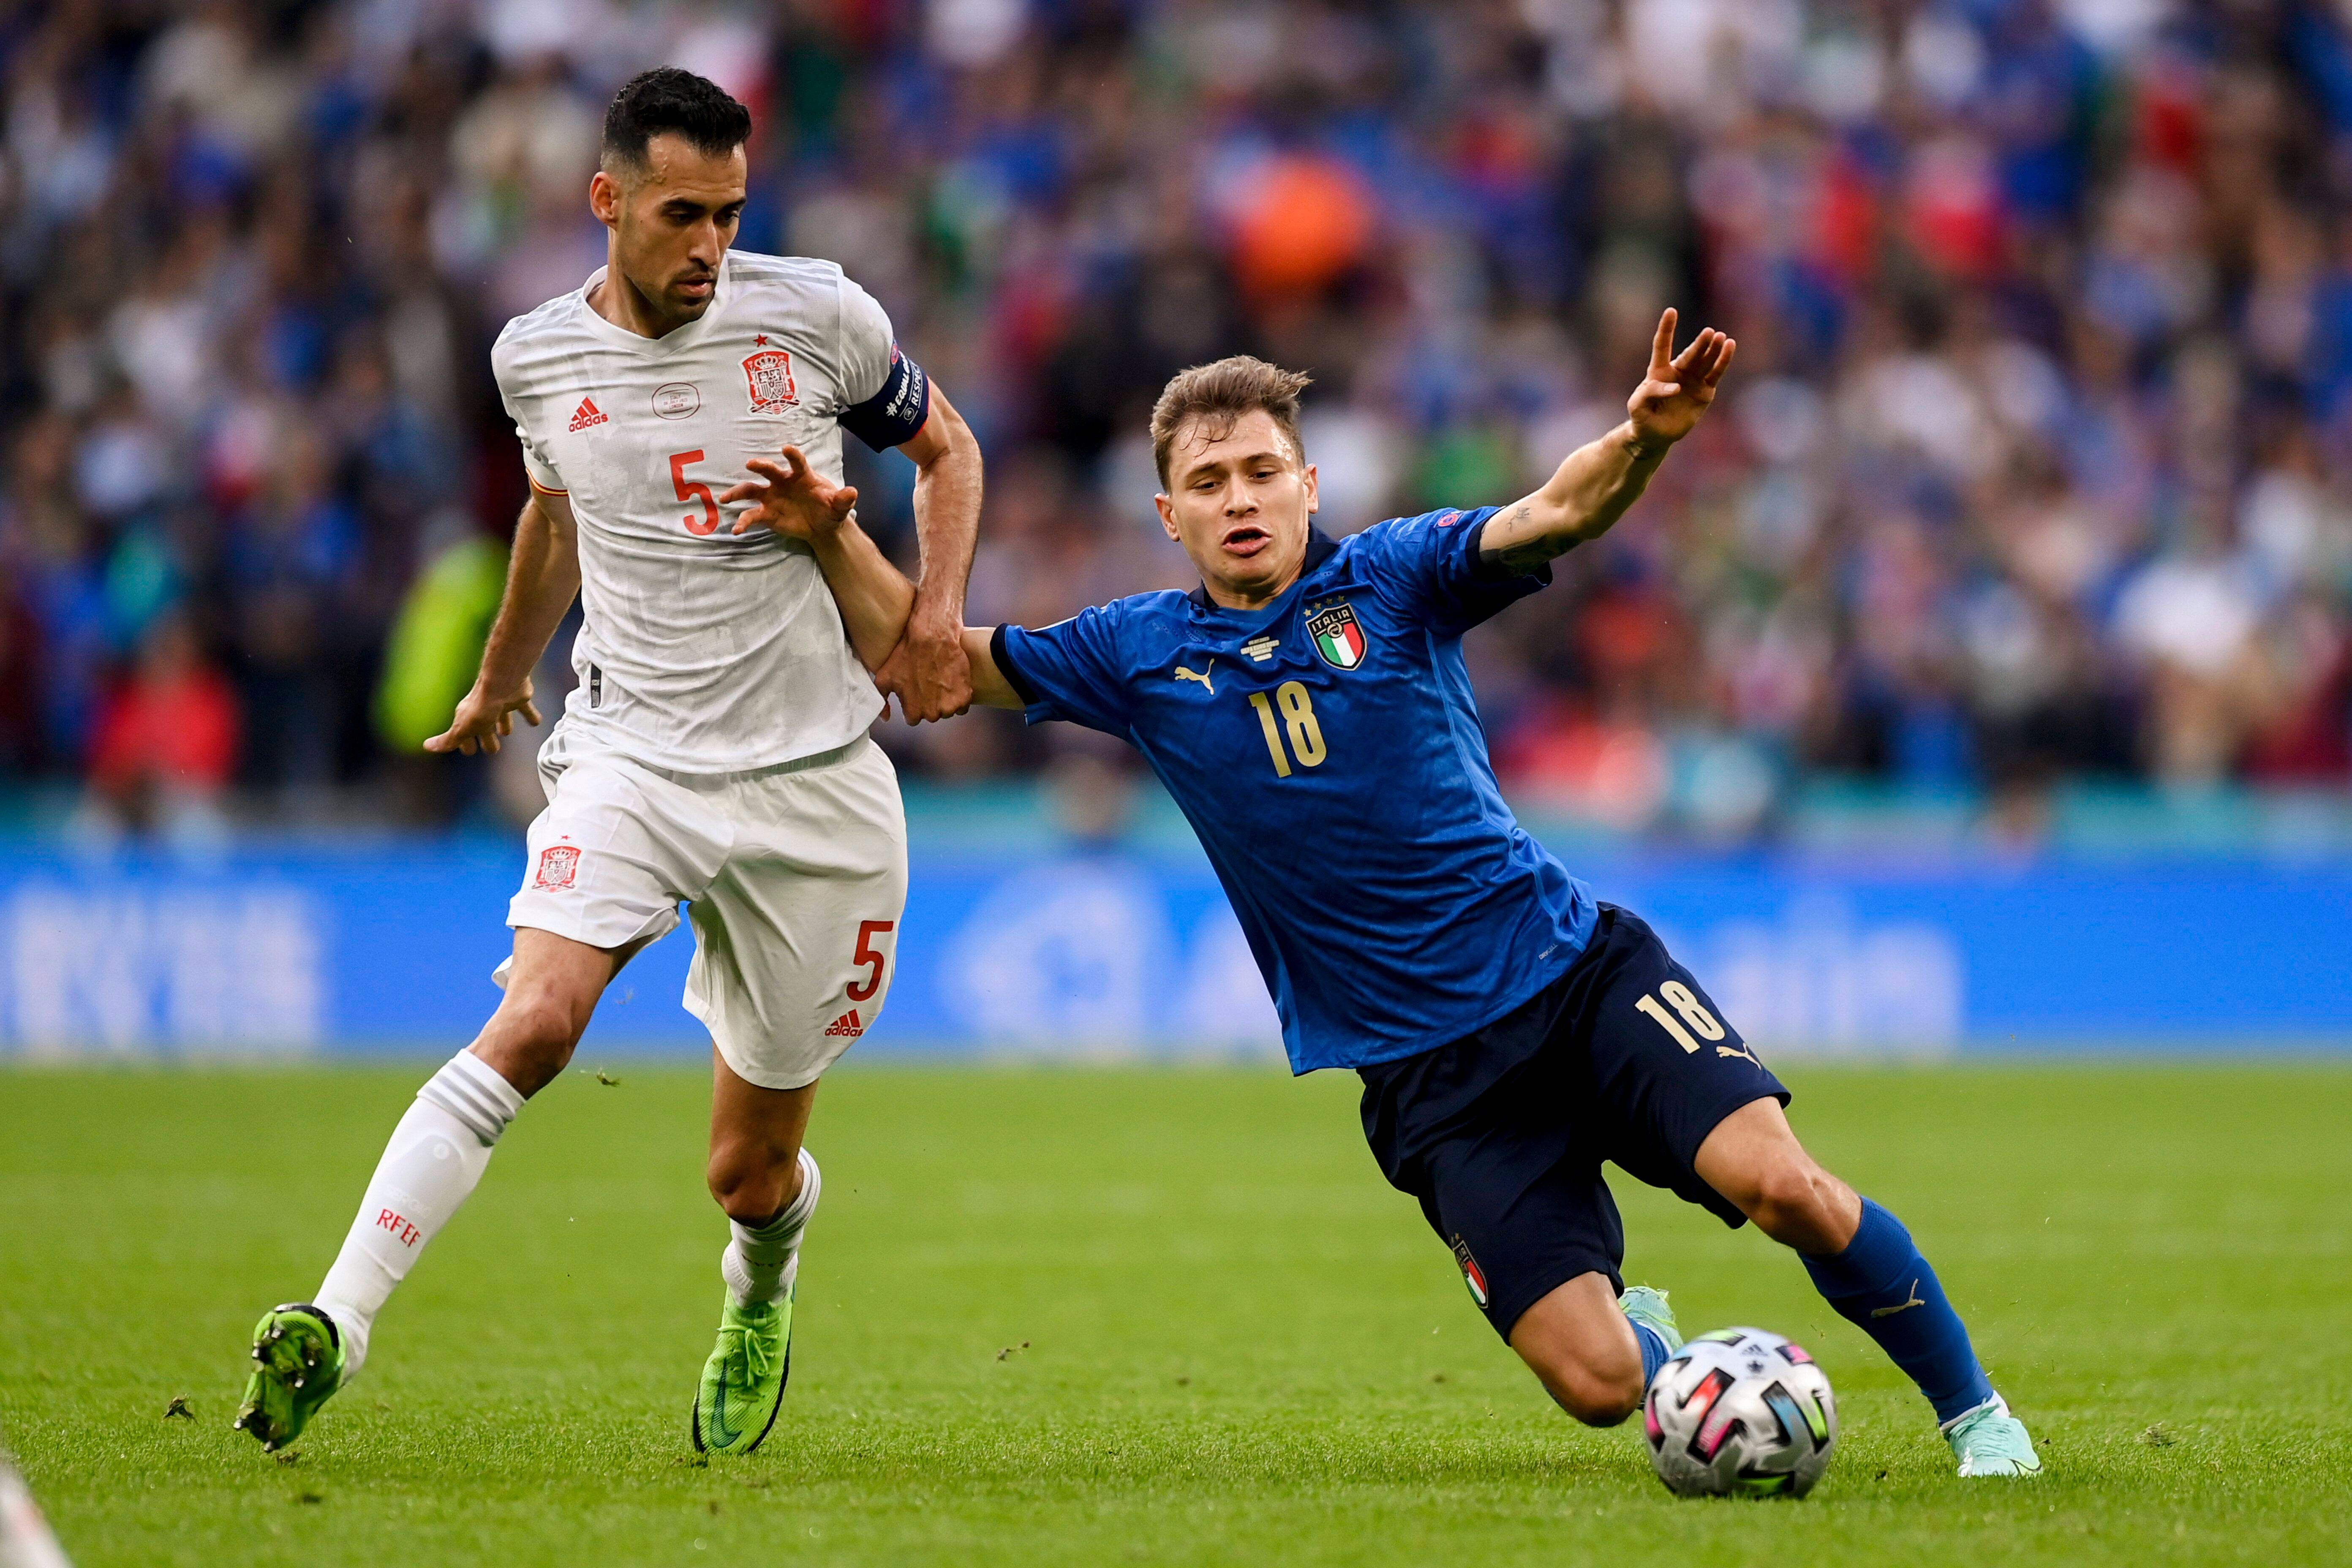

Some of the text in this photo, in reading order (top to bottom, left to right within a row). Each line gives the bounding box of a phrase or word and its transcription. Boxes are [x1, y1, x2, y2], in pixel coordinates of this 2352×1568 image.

[569, 414, 608, 432] adidas
[669, 449, 719, 535] 5
[1311, 609, 1350, 632] ITALIA
[1248, 681, 1327, 778] 18
[846, 920, 893, 1002] 5
[825, 1026, 863, 1037] adidas
[1635, 980, 1725, 1054] 18
[376, 1209, 421, 1247] RFEF
